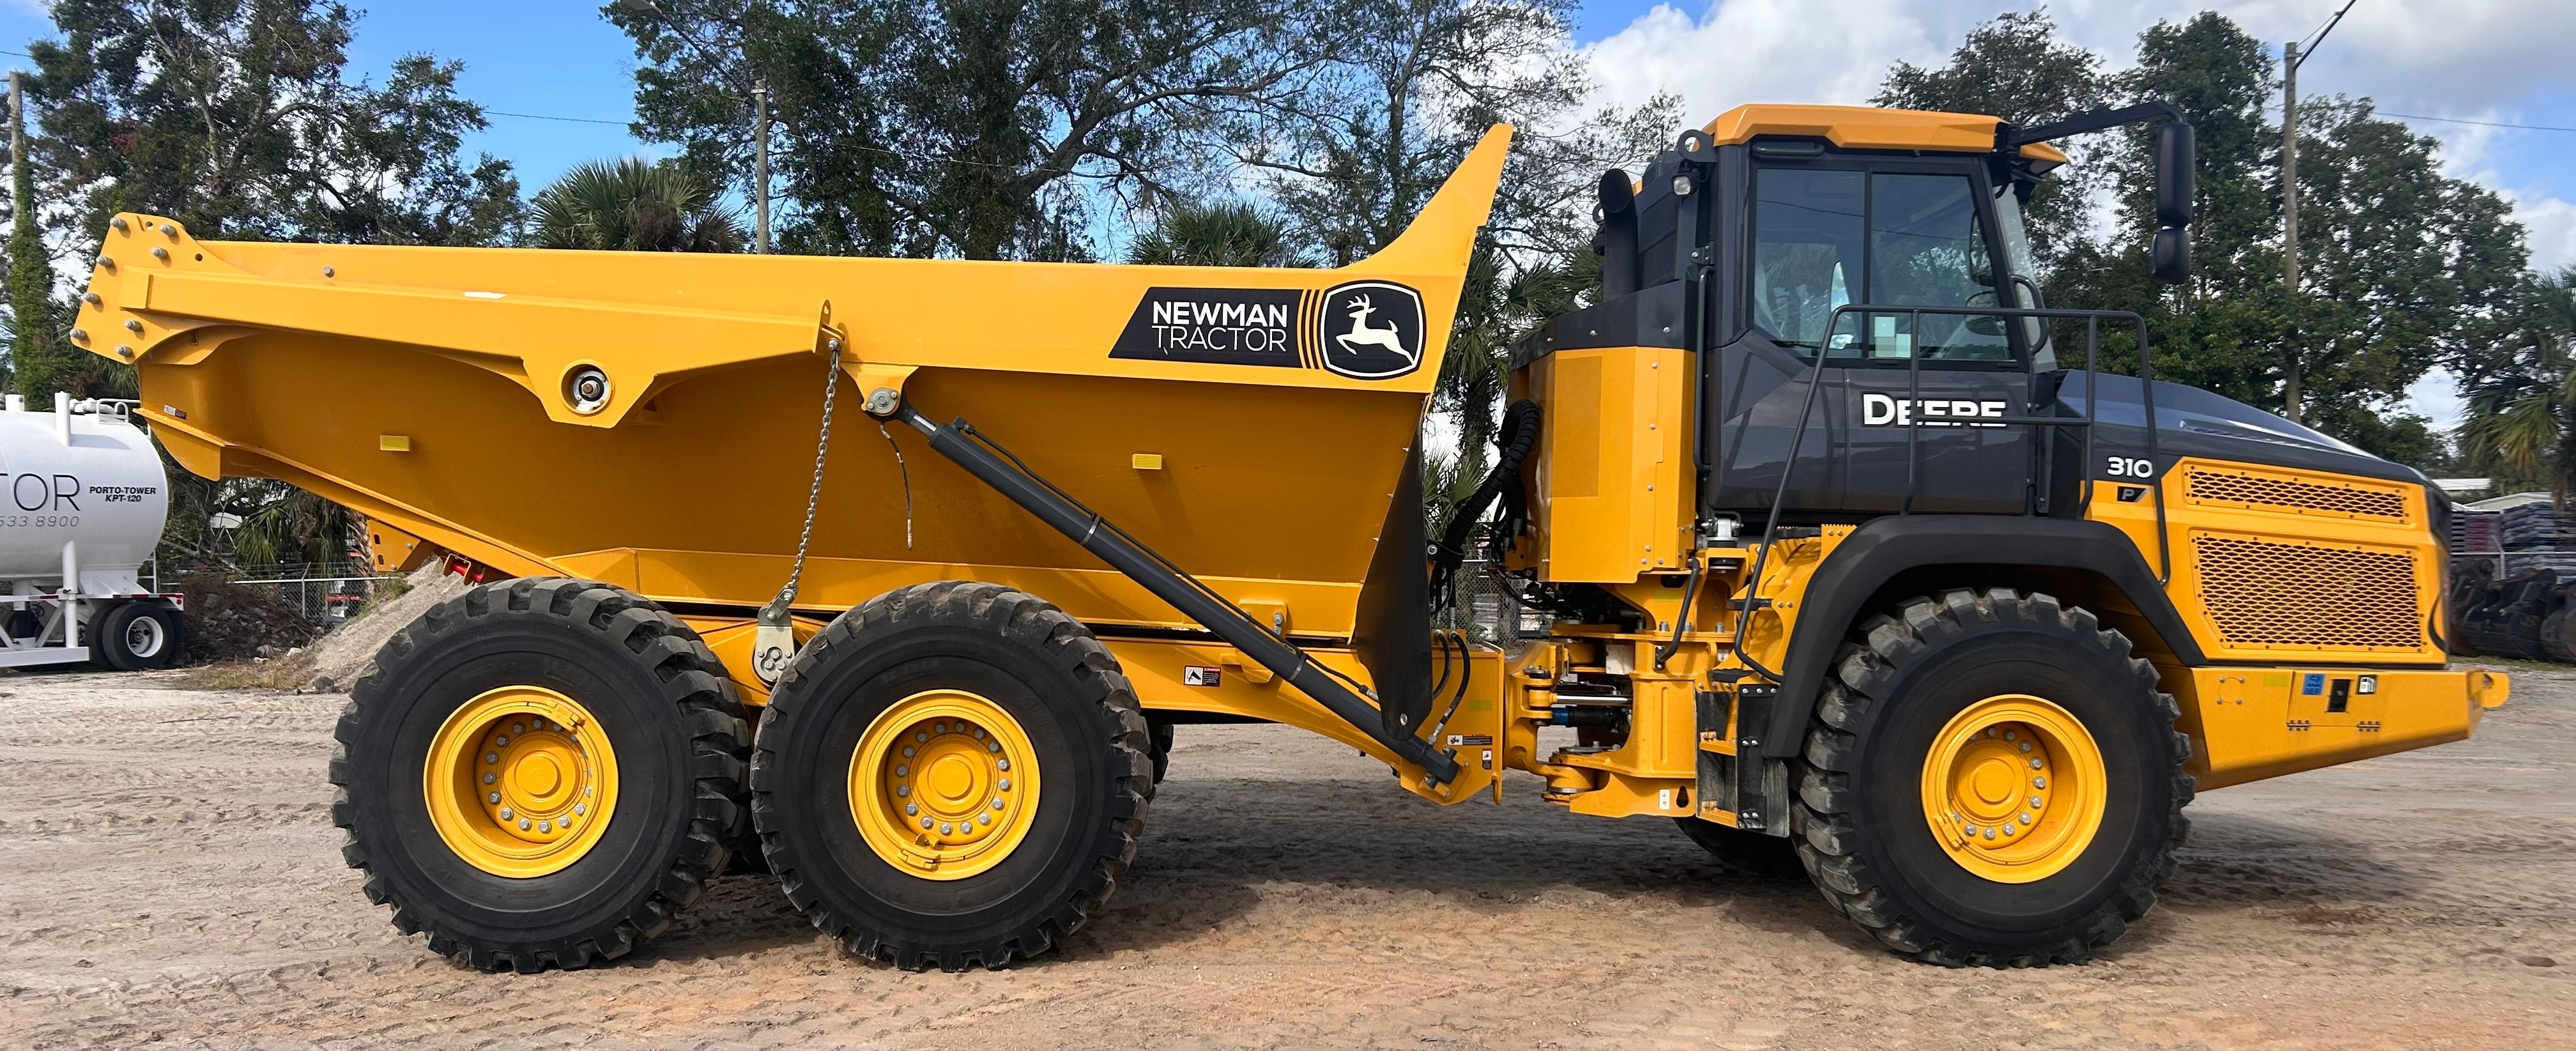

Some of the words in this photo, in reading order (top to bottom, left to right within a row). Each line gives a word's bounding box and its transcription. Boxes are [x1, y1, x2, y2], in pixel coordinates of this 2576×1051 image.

[1153, 301, 1287, 327] NEWMAN
[1151, 325, 1287, 351] TRACTOR
[1863, 394, 2007, 427] DEERE
[2107, 456, 2153, 478] 310
[0, 473, 80, 511] OR
[89, 486, 157, 495] PORTO-TOWER
[2121, 488, 2135, 500] P
